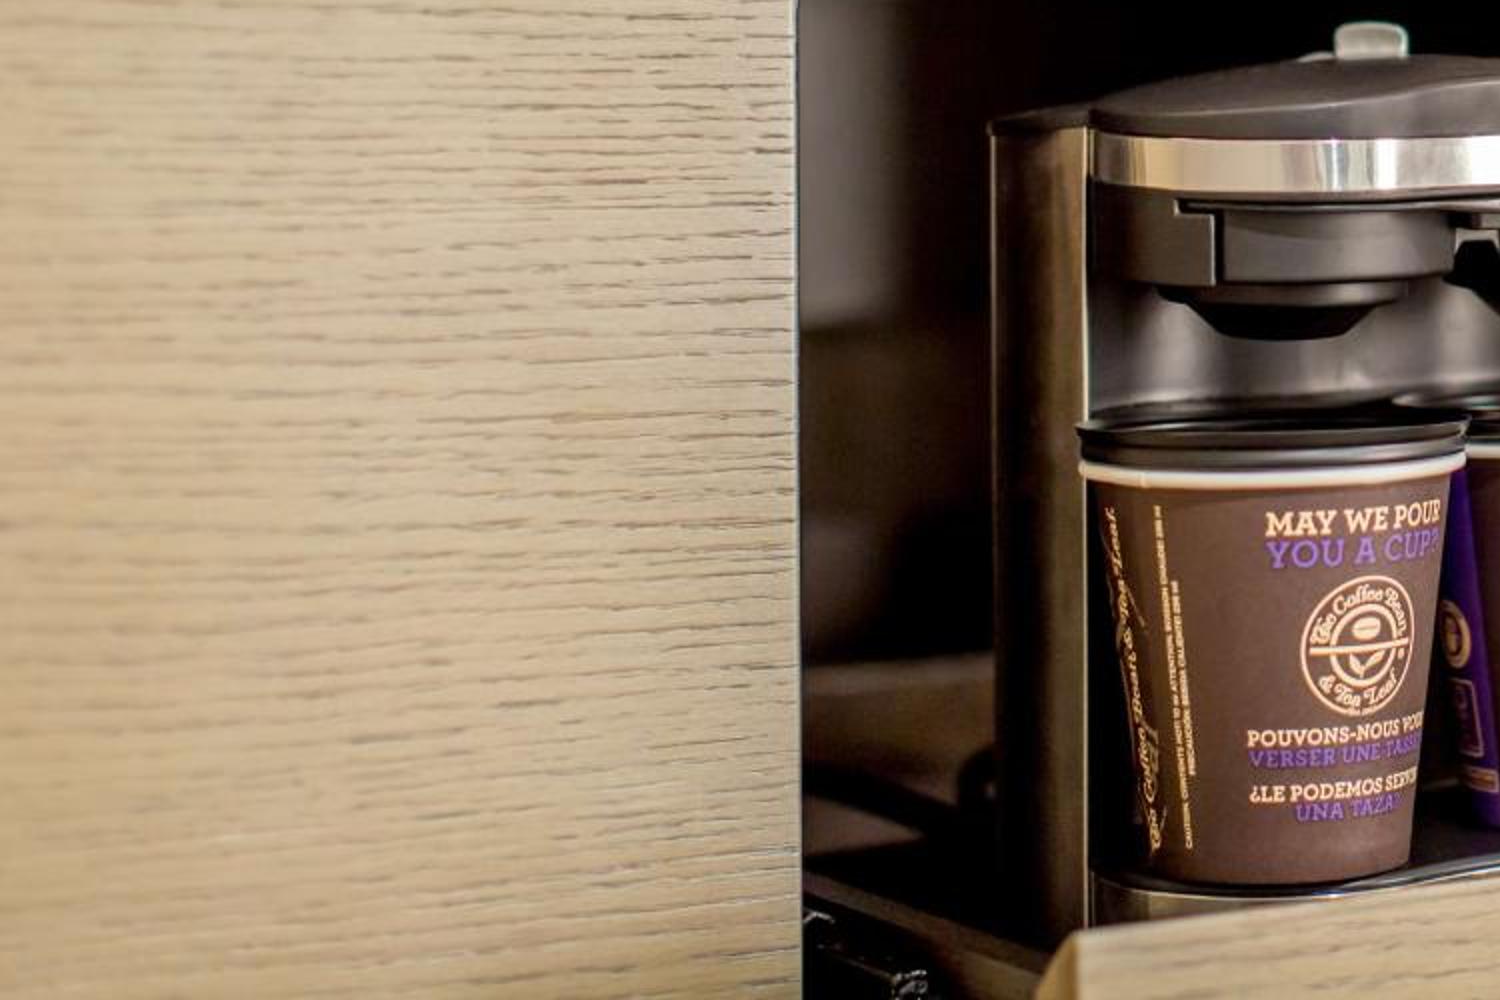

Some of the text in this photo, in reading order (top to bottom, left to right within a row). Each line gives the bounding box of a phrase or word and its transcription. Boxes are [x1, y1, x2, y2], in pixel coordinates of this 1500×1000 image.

[1265, 499, 1441, 537] MAY WE POUR
[1266, 527, 1440, 569] YOU A CUP?
[1310, 614, 1336, 644] The
[1332, 584, 1384, 614] Coffee
[1318, 674, 1335, 694] &
[1247, 718, 1399, 748] POUVONS-NOUS
[1249, 750, 1336, 768] VERSER
[1342, 741, 1382, 764] UNE
[1289, 777, 1383, 802] PODEMOS
[1296, 803, 1344, 822] UNA
